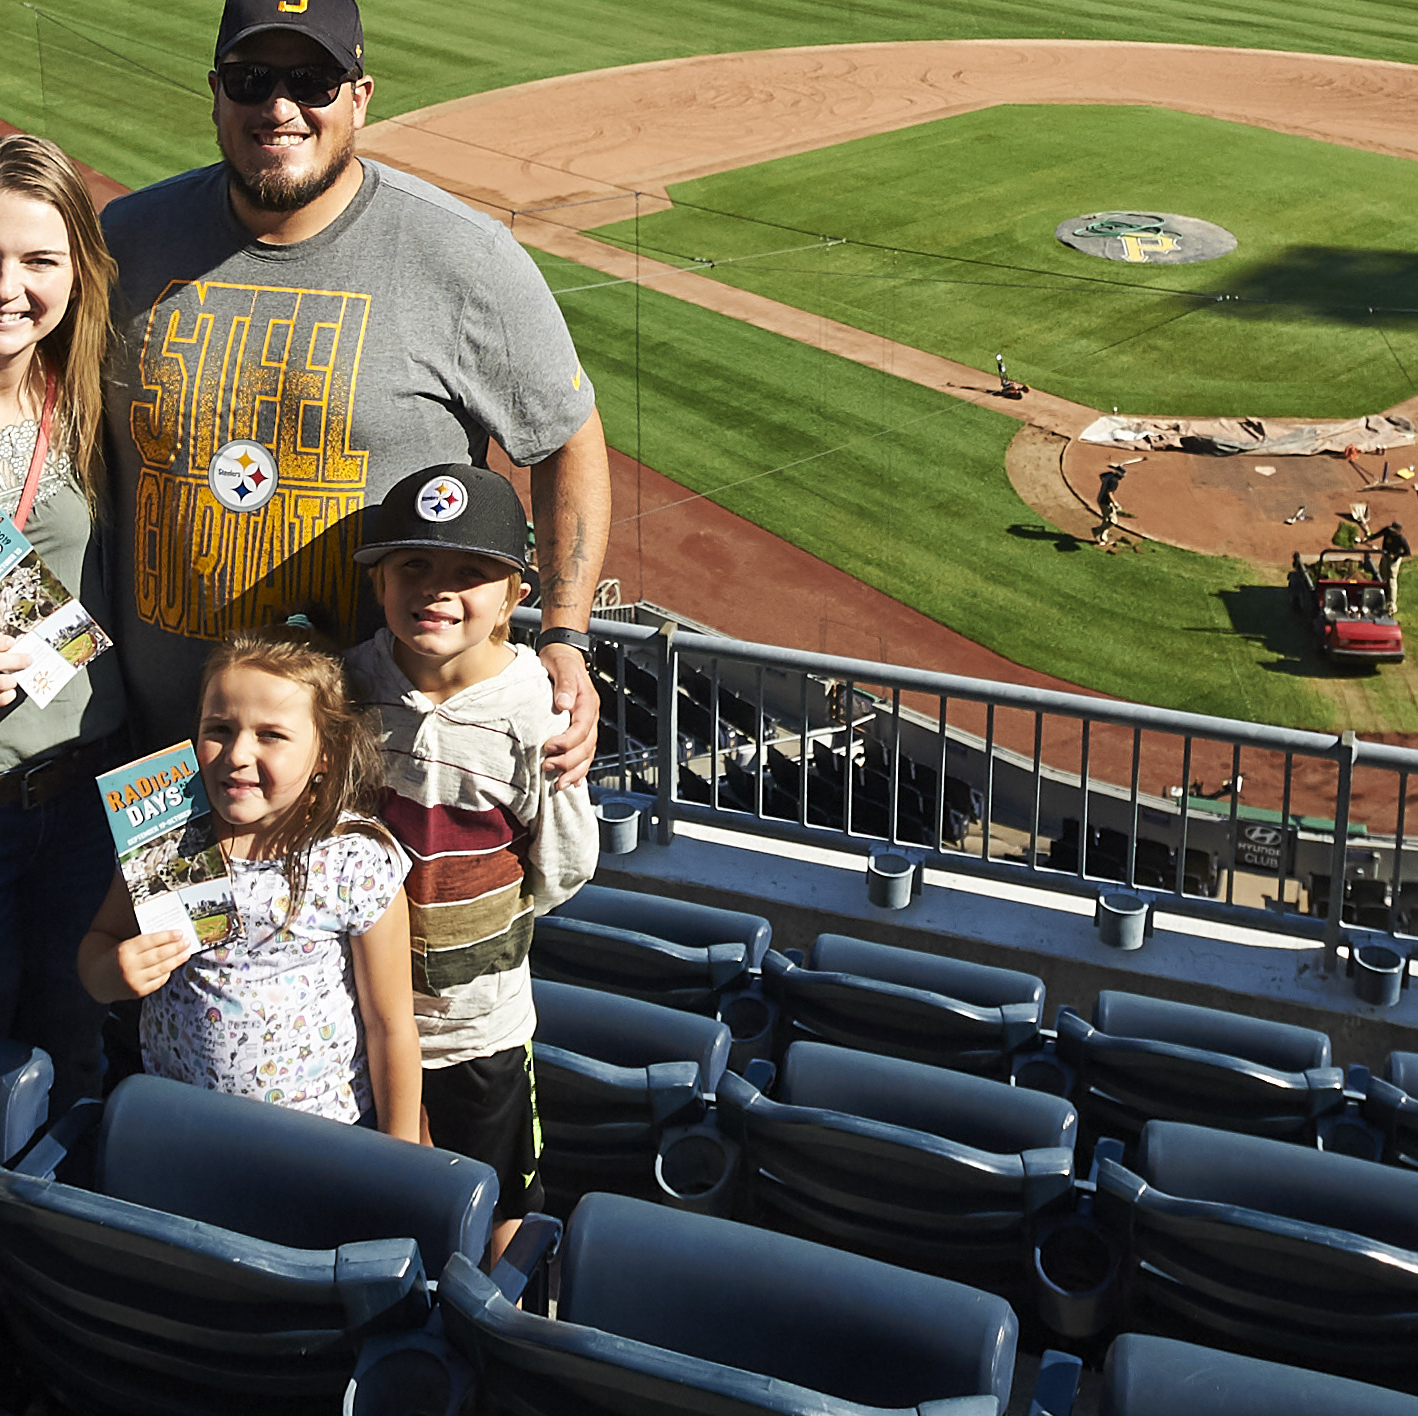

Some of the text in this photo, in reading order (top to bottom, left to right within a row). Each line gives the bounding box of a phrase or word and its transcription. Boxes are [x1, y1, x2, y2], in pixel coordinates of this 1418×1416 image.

[1117, 232, 1182, 263] P
[131, 279, 372, 488] STEEL
[218, 467, 241, 478] Steelers
[134, 466, 366, 642] CURTAIN
[106, 760, 196, 813] RADICAL
[126, 786, 183, 828] DAYS
[127, 825, 160, 846] SEPTEMBER
[1244, 853, 1279, 868] CLUB
